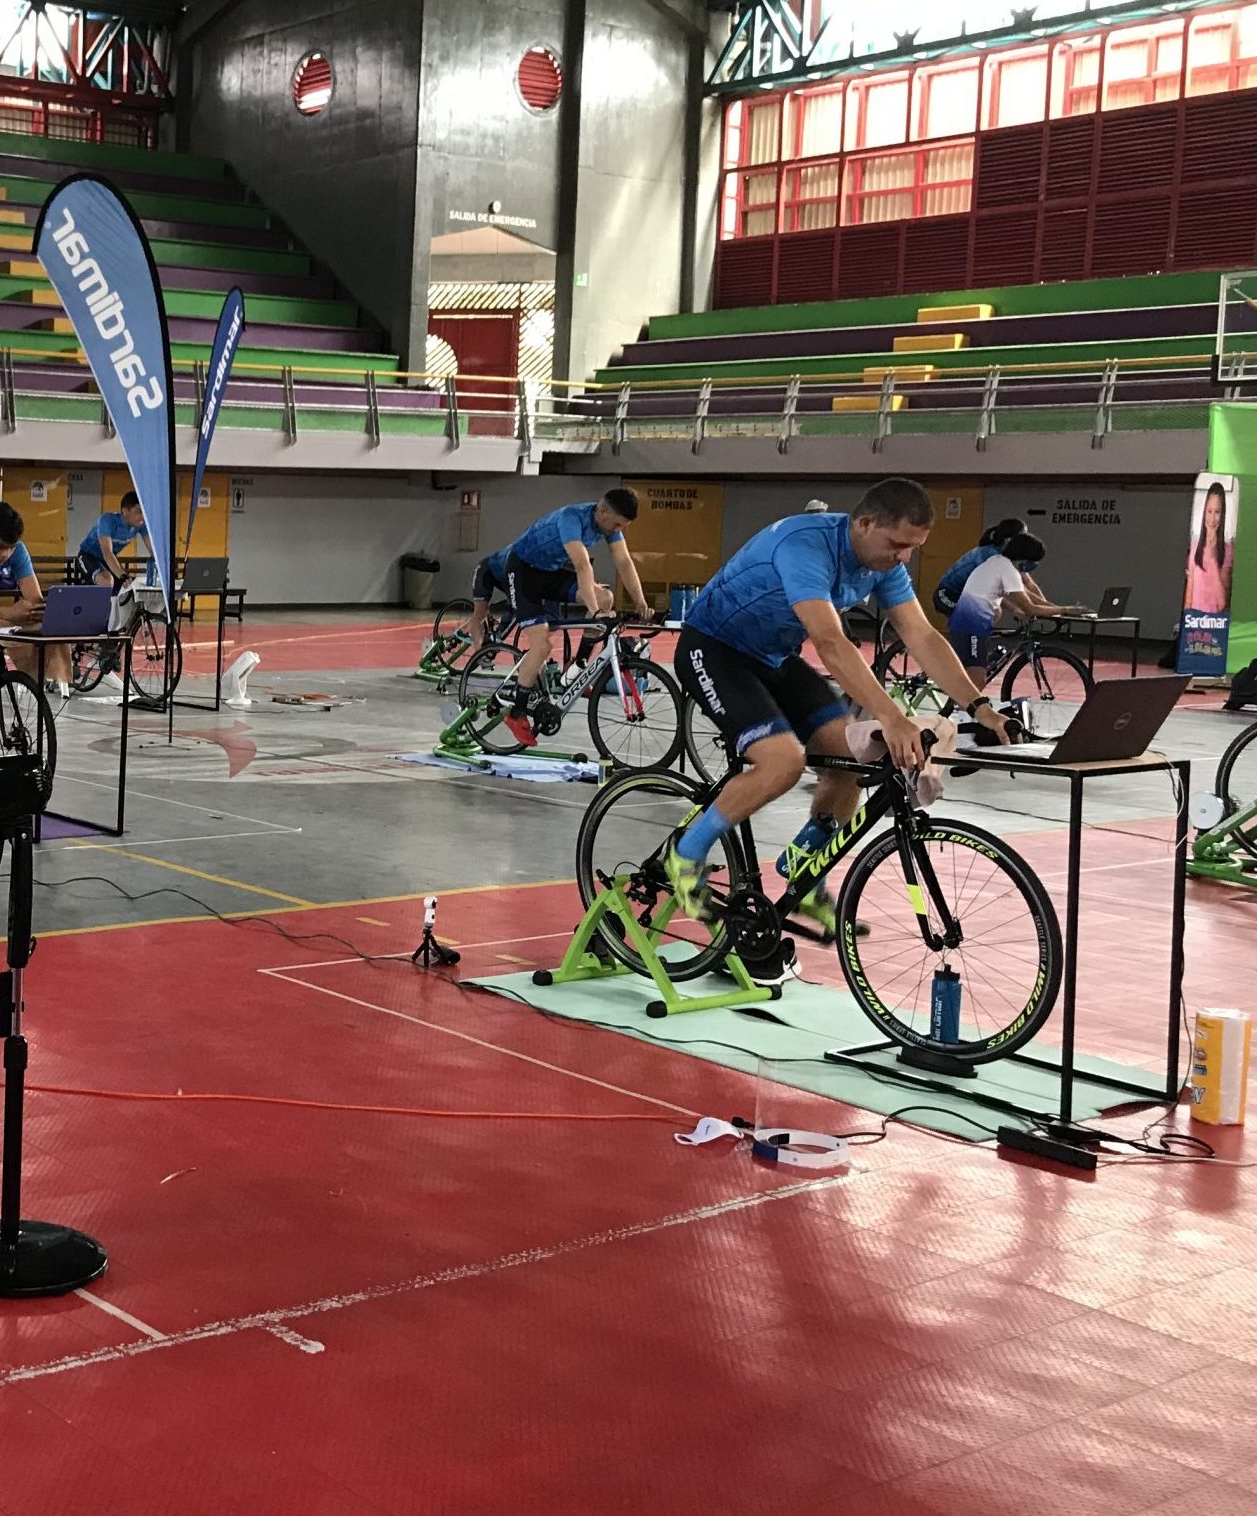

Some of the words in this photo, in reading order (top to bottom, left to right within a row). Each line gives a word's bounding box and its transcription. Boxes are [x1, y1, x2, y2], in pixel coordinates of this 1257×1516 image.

[449, 210, 476, 222] SALIDA
[478, 213, 489, 223] DE
[489, 214, 536, 228] EMERGENCIA
[201, 304, 243, 440] Sardimar
[651, 500, 693, 510] BOMBAS
[1052, 513, 1121, 525] EMERGENCIA
[1057, 500, 1097, 511] SALIDA
[1102, 500, 1116, 511] DE
[1184, 614, 1228, 629] Sardimar
[562, 657, 605, 706] ORBEA
[690, 649, 726, 717] Sardimar
[810, 805, 867, 877] WILD
[949, 833, 999, 859] BIKES
[845, 920, 861, 973] BIKES
[856, 975, 885, 1015] WILD
[1027, 970, 1046, 1016] WILD
[986, 1013, 1025, 1050] BIKES
